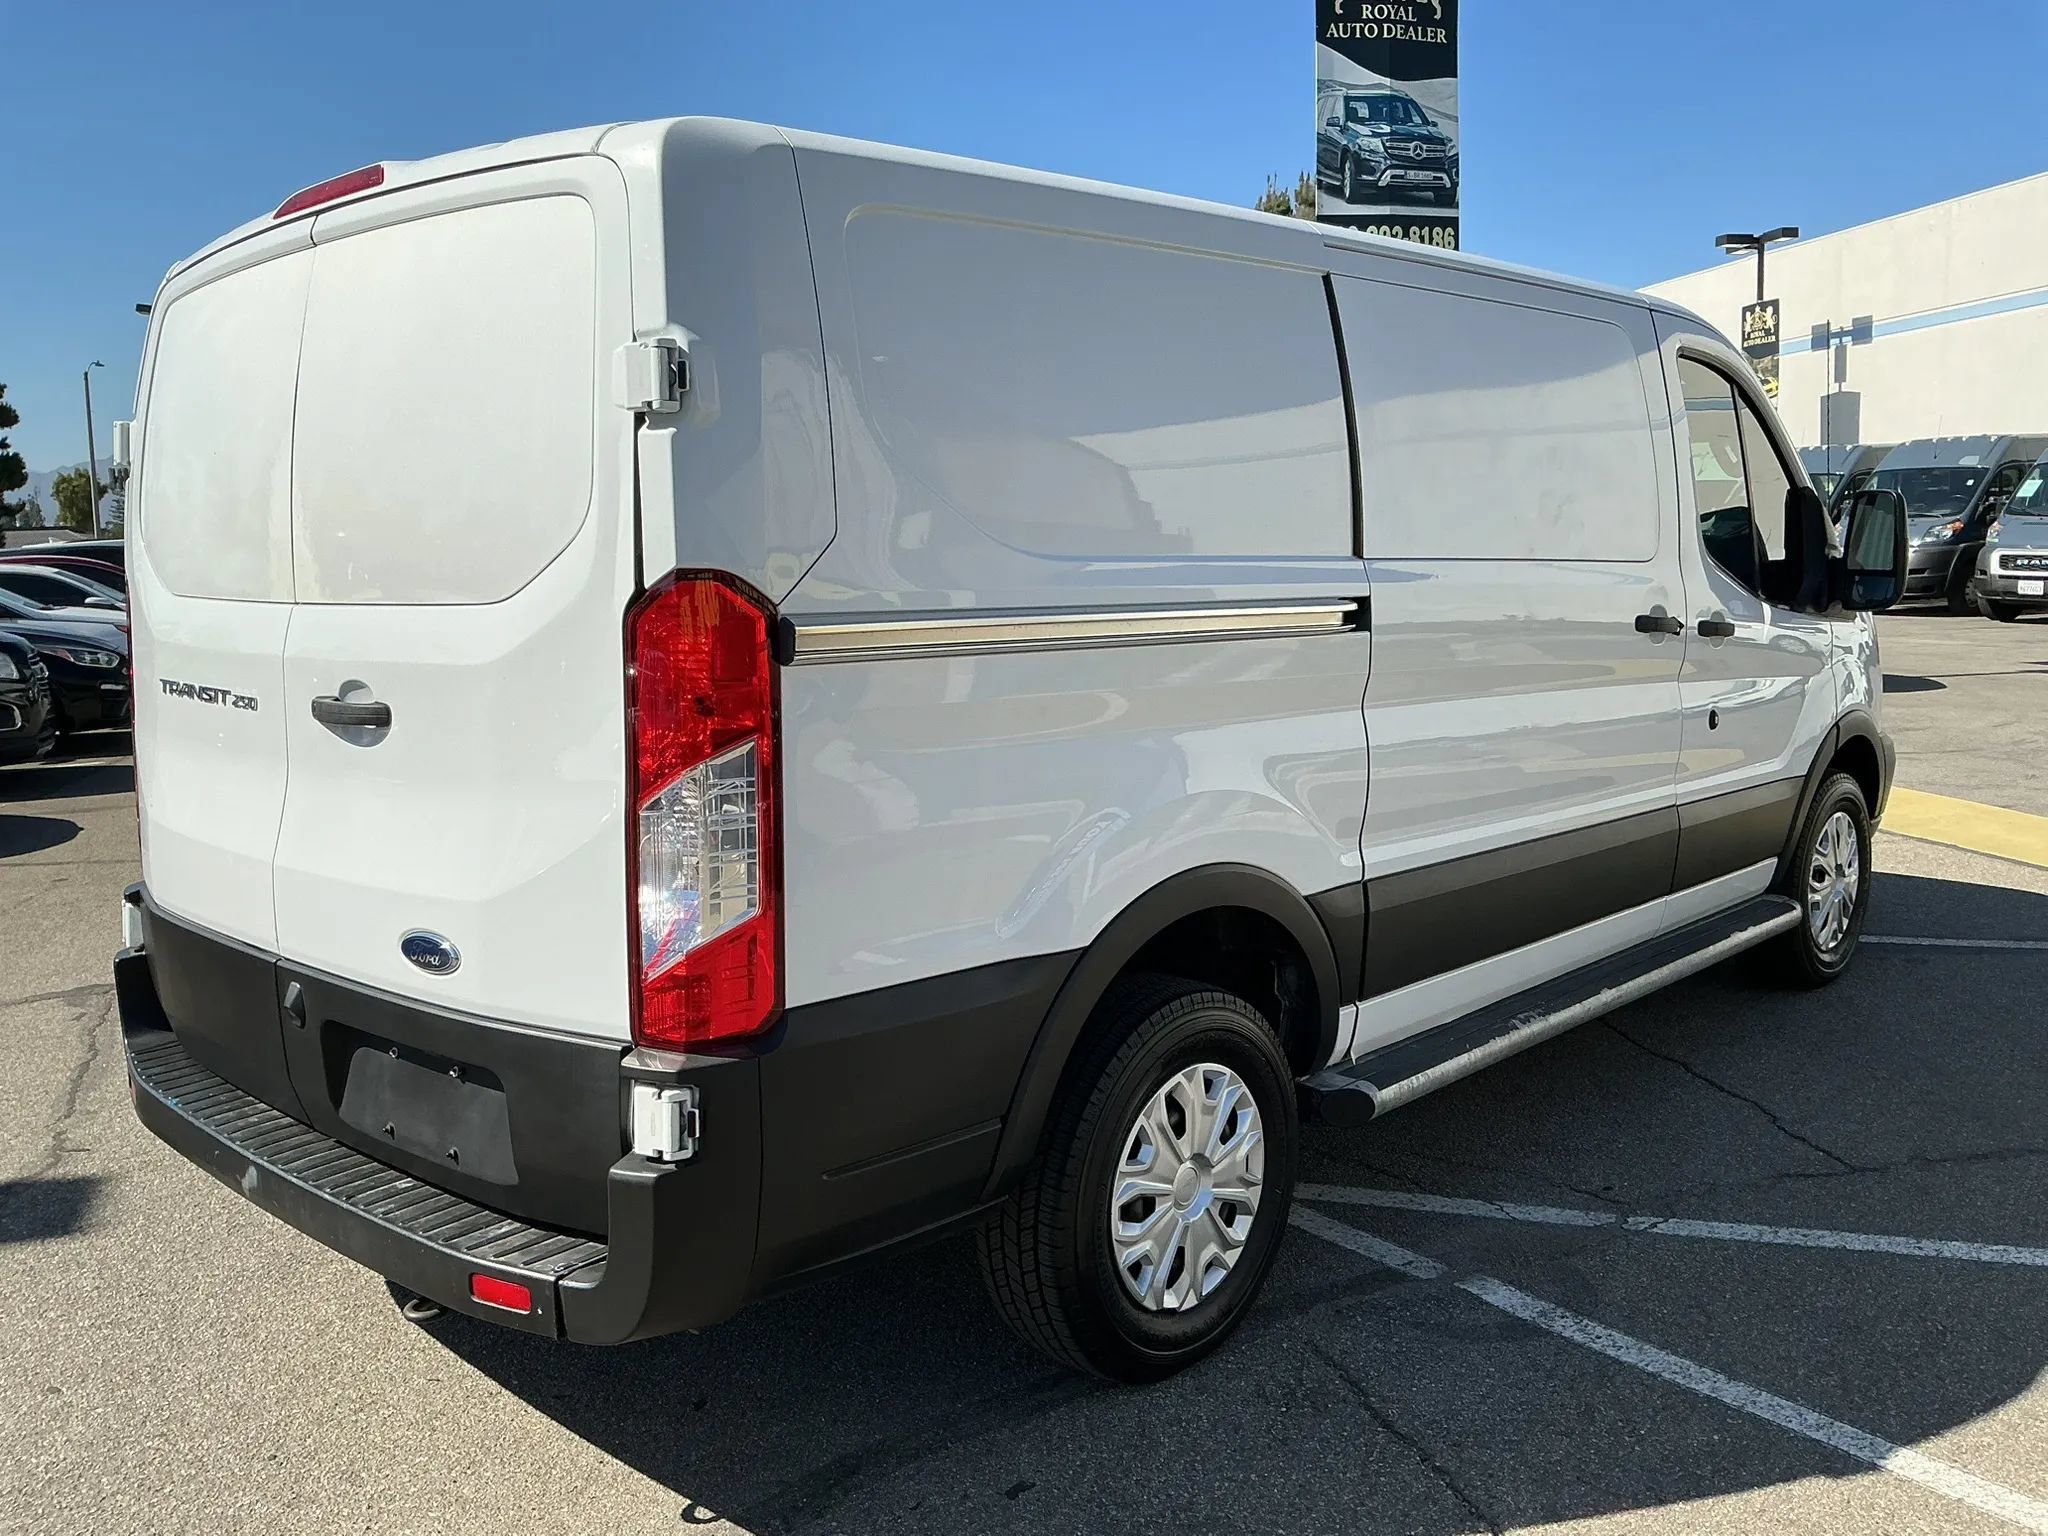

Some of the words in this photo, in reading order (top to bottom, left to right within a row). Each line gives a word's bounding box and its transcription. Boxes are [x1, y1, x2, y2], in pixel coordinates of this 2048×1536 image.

[1361, 4, 1417, 22] ROYAL
[1326, 22, 1378, 39] AUTO
[1382, 23, 1447, 44] DEALER
[159, 679, 231, 707] TRANSIT
[231, 694, 258, 712] 250
[410, 940, 441, 966] Ford
